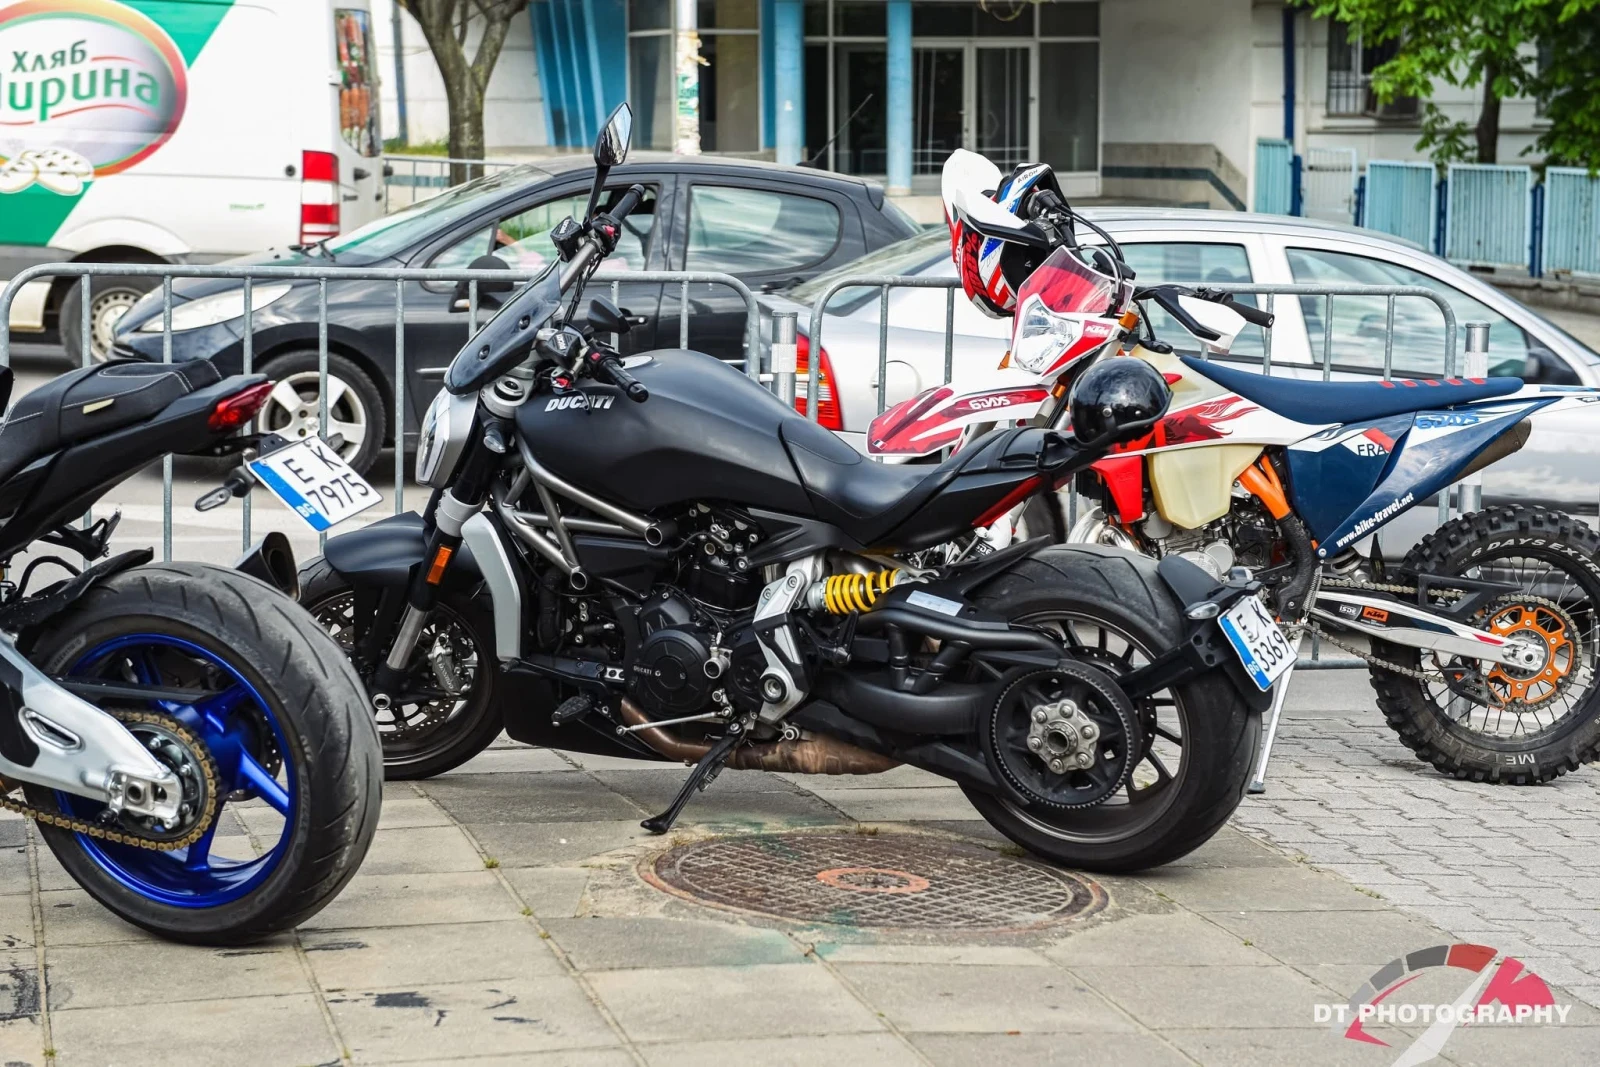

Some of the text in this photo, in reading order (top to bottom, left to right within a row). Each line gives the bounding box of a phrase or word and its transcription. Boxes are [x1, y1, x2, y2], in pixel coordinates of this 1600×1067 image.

[12, 39, 87, 73] Хляб
[0, 68, 160, 121] ирина
[1085, 325, 1110, 336] KTM
[282, 446, 342, 484] E K
[305, 473, 369, 515] 7975
[1335, 492, 1414, 548] www.bike-travel.net
[1487, 538, 1546, 551] DAYS
[1250, 601, 1271, 627] K
[1366, 610, 1385, 619] KTM
[1253, 630, 1289, 672] 3369
